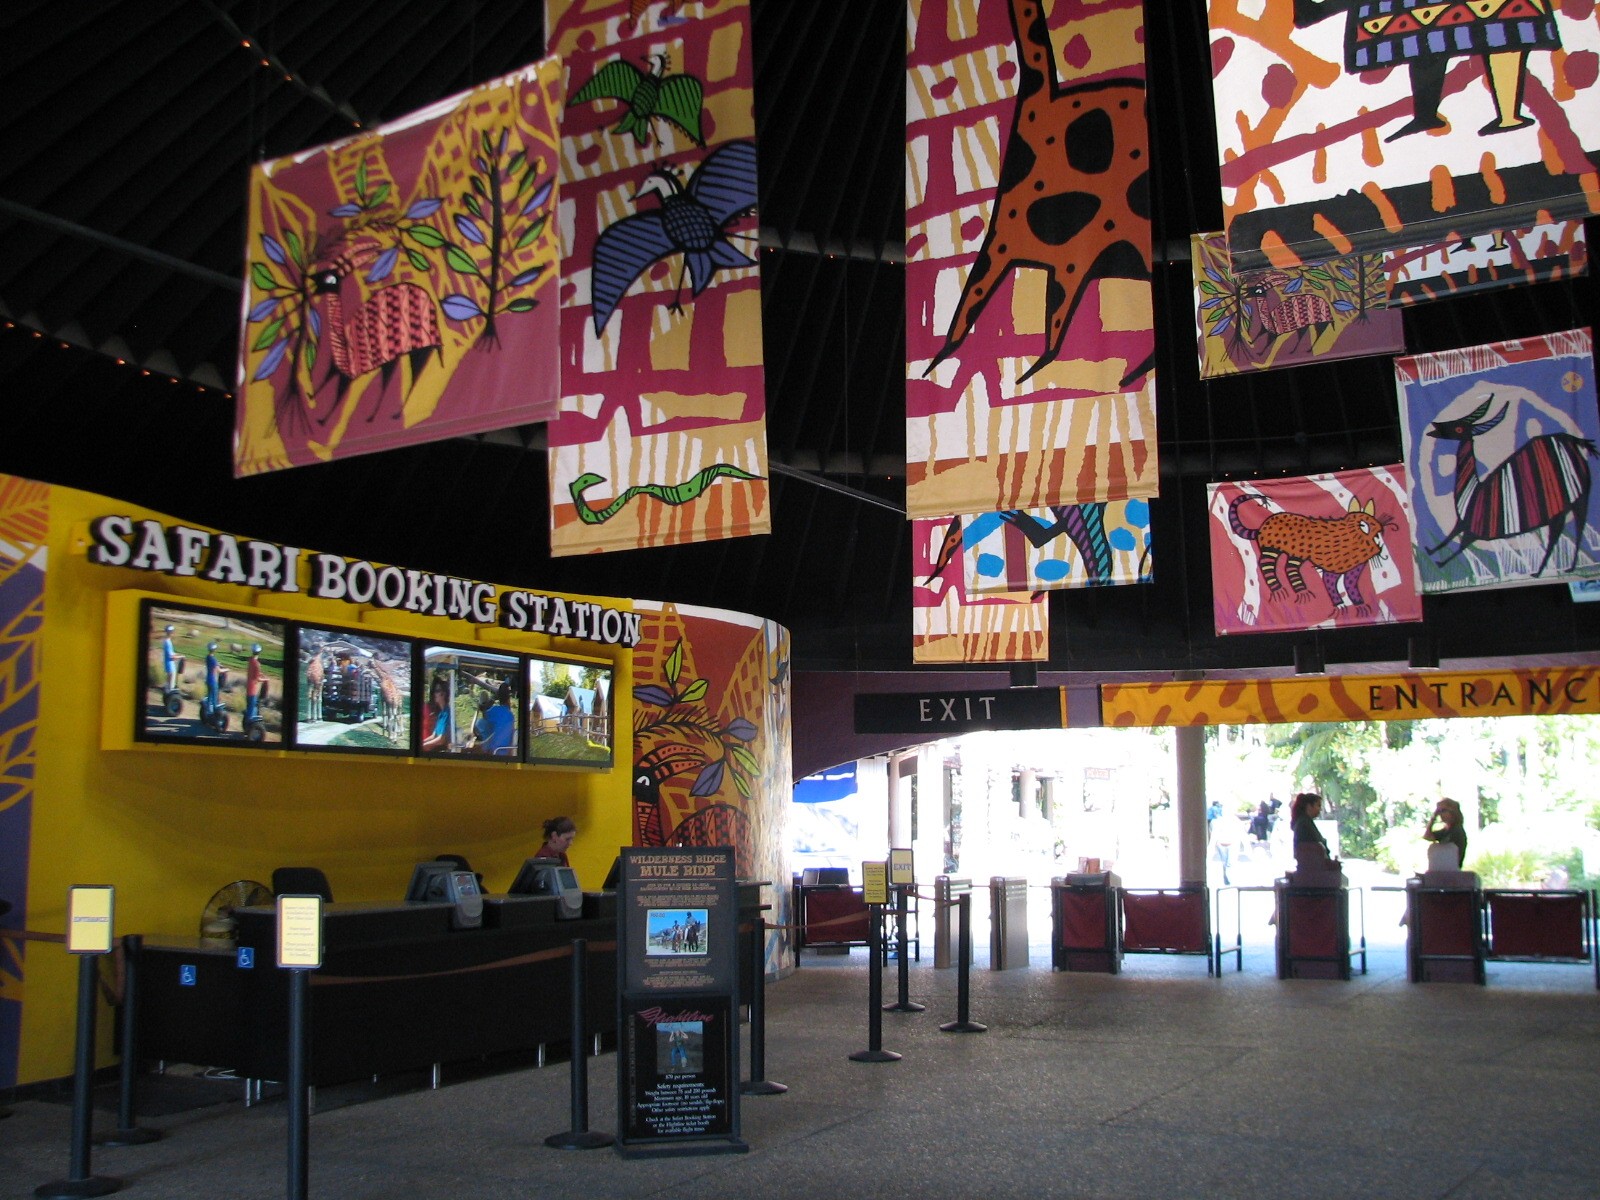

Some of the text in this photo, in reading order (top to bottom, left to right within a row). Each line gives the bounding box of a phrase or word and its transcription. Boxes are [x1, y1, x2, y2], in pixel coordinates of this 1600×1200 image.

[92, 515, 642, 647] SAFARI BOOKING STATION
[1369, 677, 1600, 711] ENTRANC
[919, 697, 996, 722] EXIT
[630, 855, 727, 864] WILDERNESS RIDGE
[893, 863, 912, 871] EXIT
[640, 865, 716, 877] MULE RIDE
